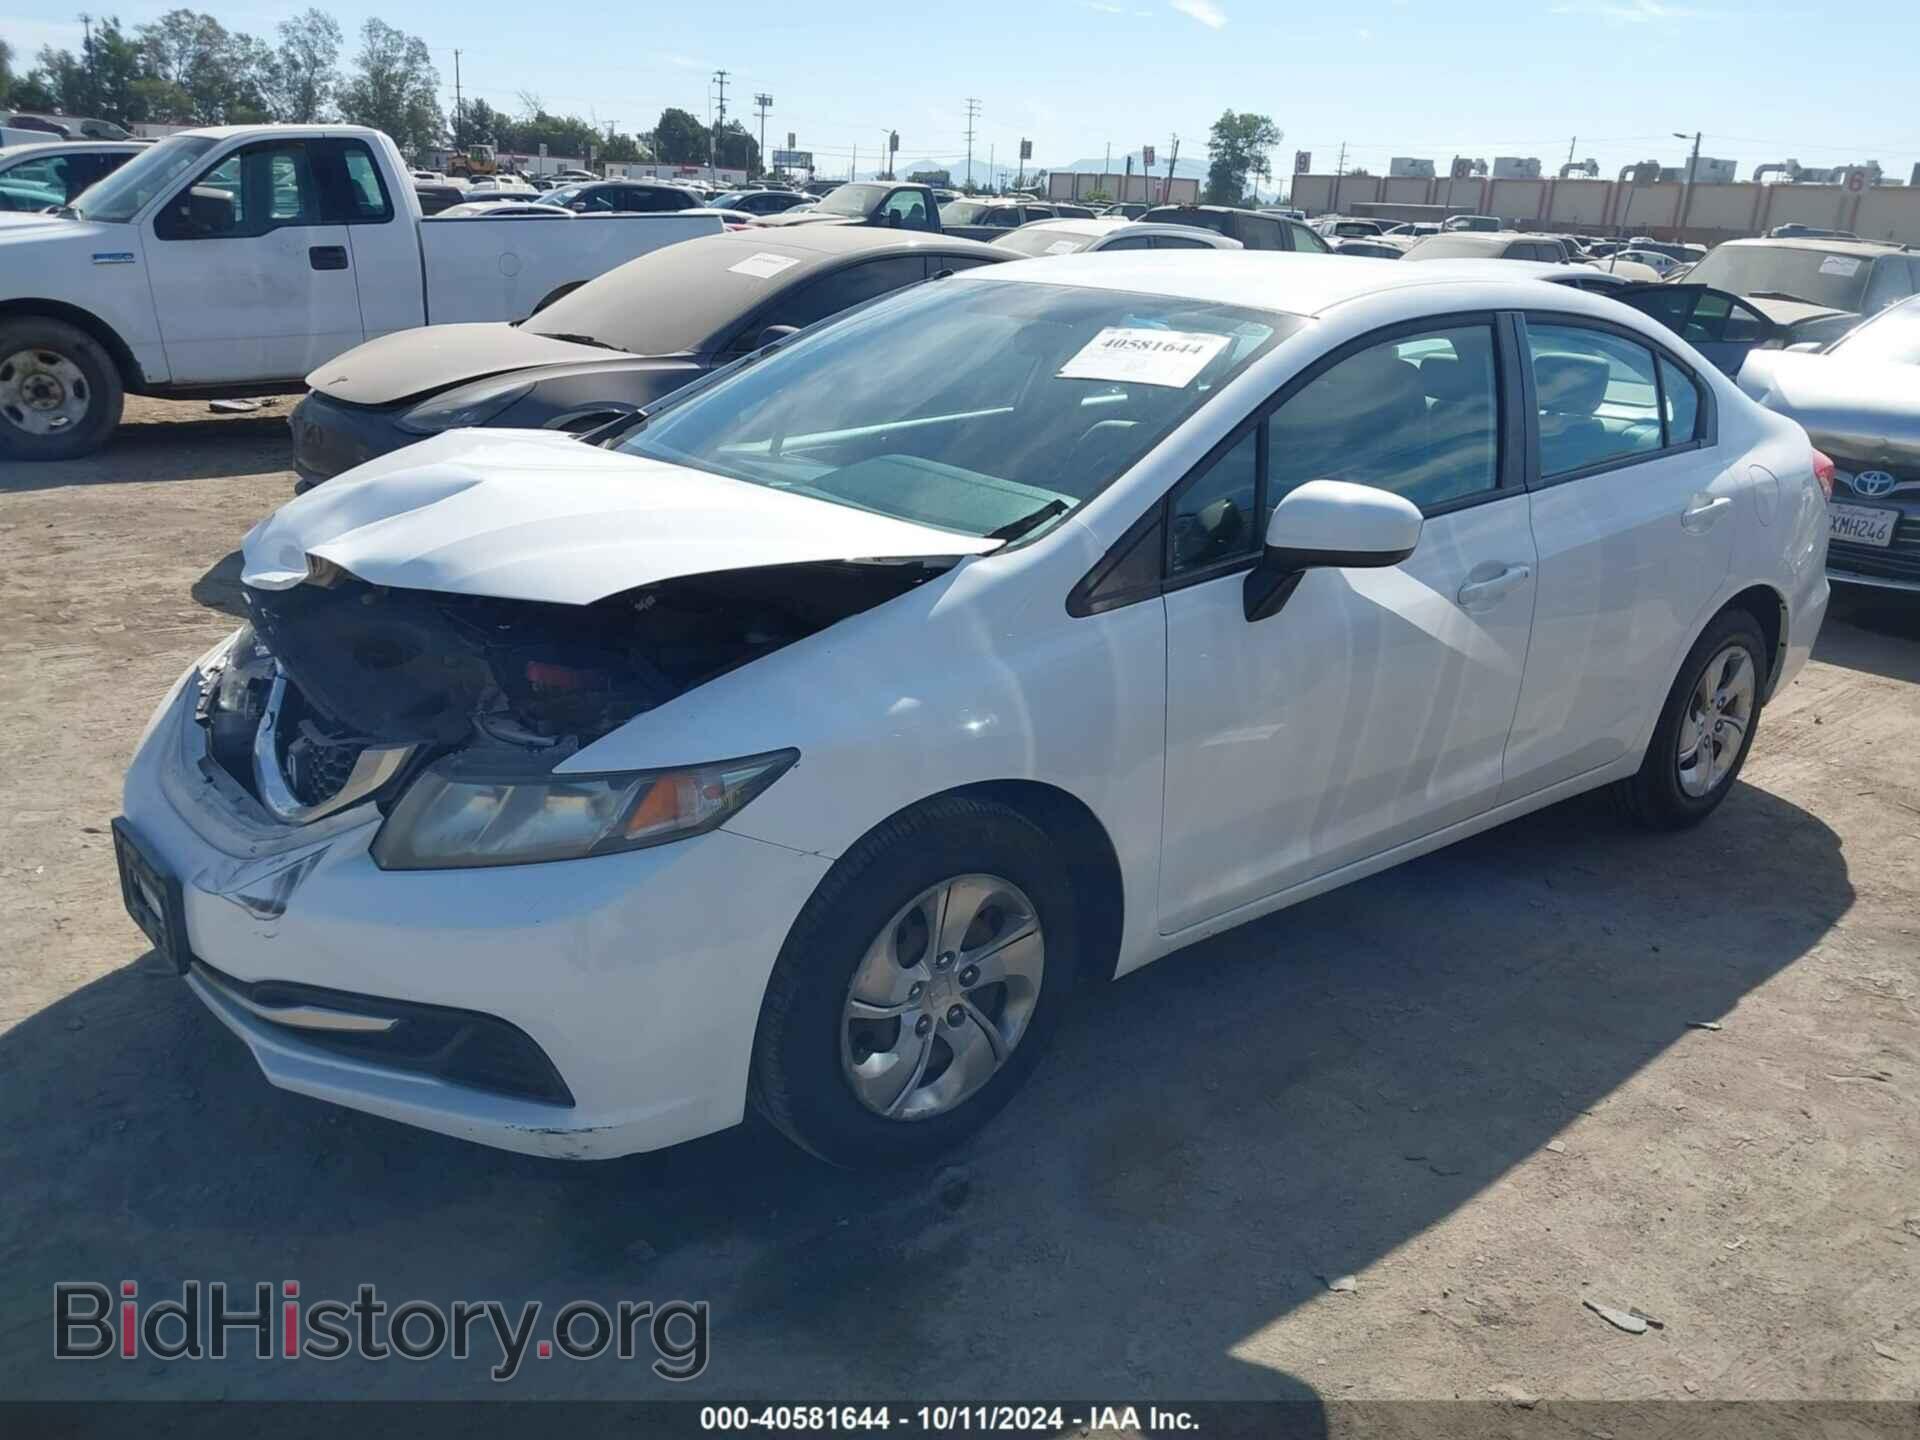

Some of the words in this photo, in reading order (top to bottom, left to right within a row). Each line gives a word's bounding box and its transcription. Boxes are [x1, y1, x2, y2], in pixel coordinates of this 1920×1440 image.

[1848, 171, 1864, 192] 6
[1101, 338, 1203, 355] 40581644
[1830, 515, 1887, 540] XMH246
